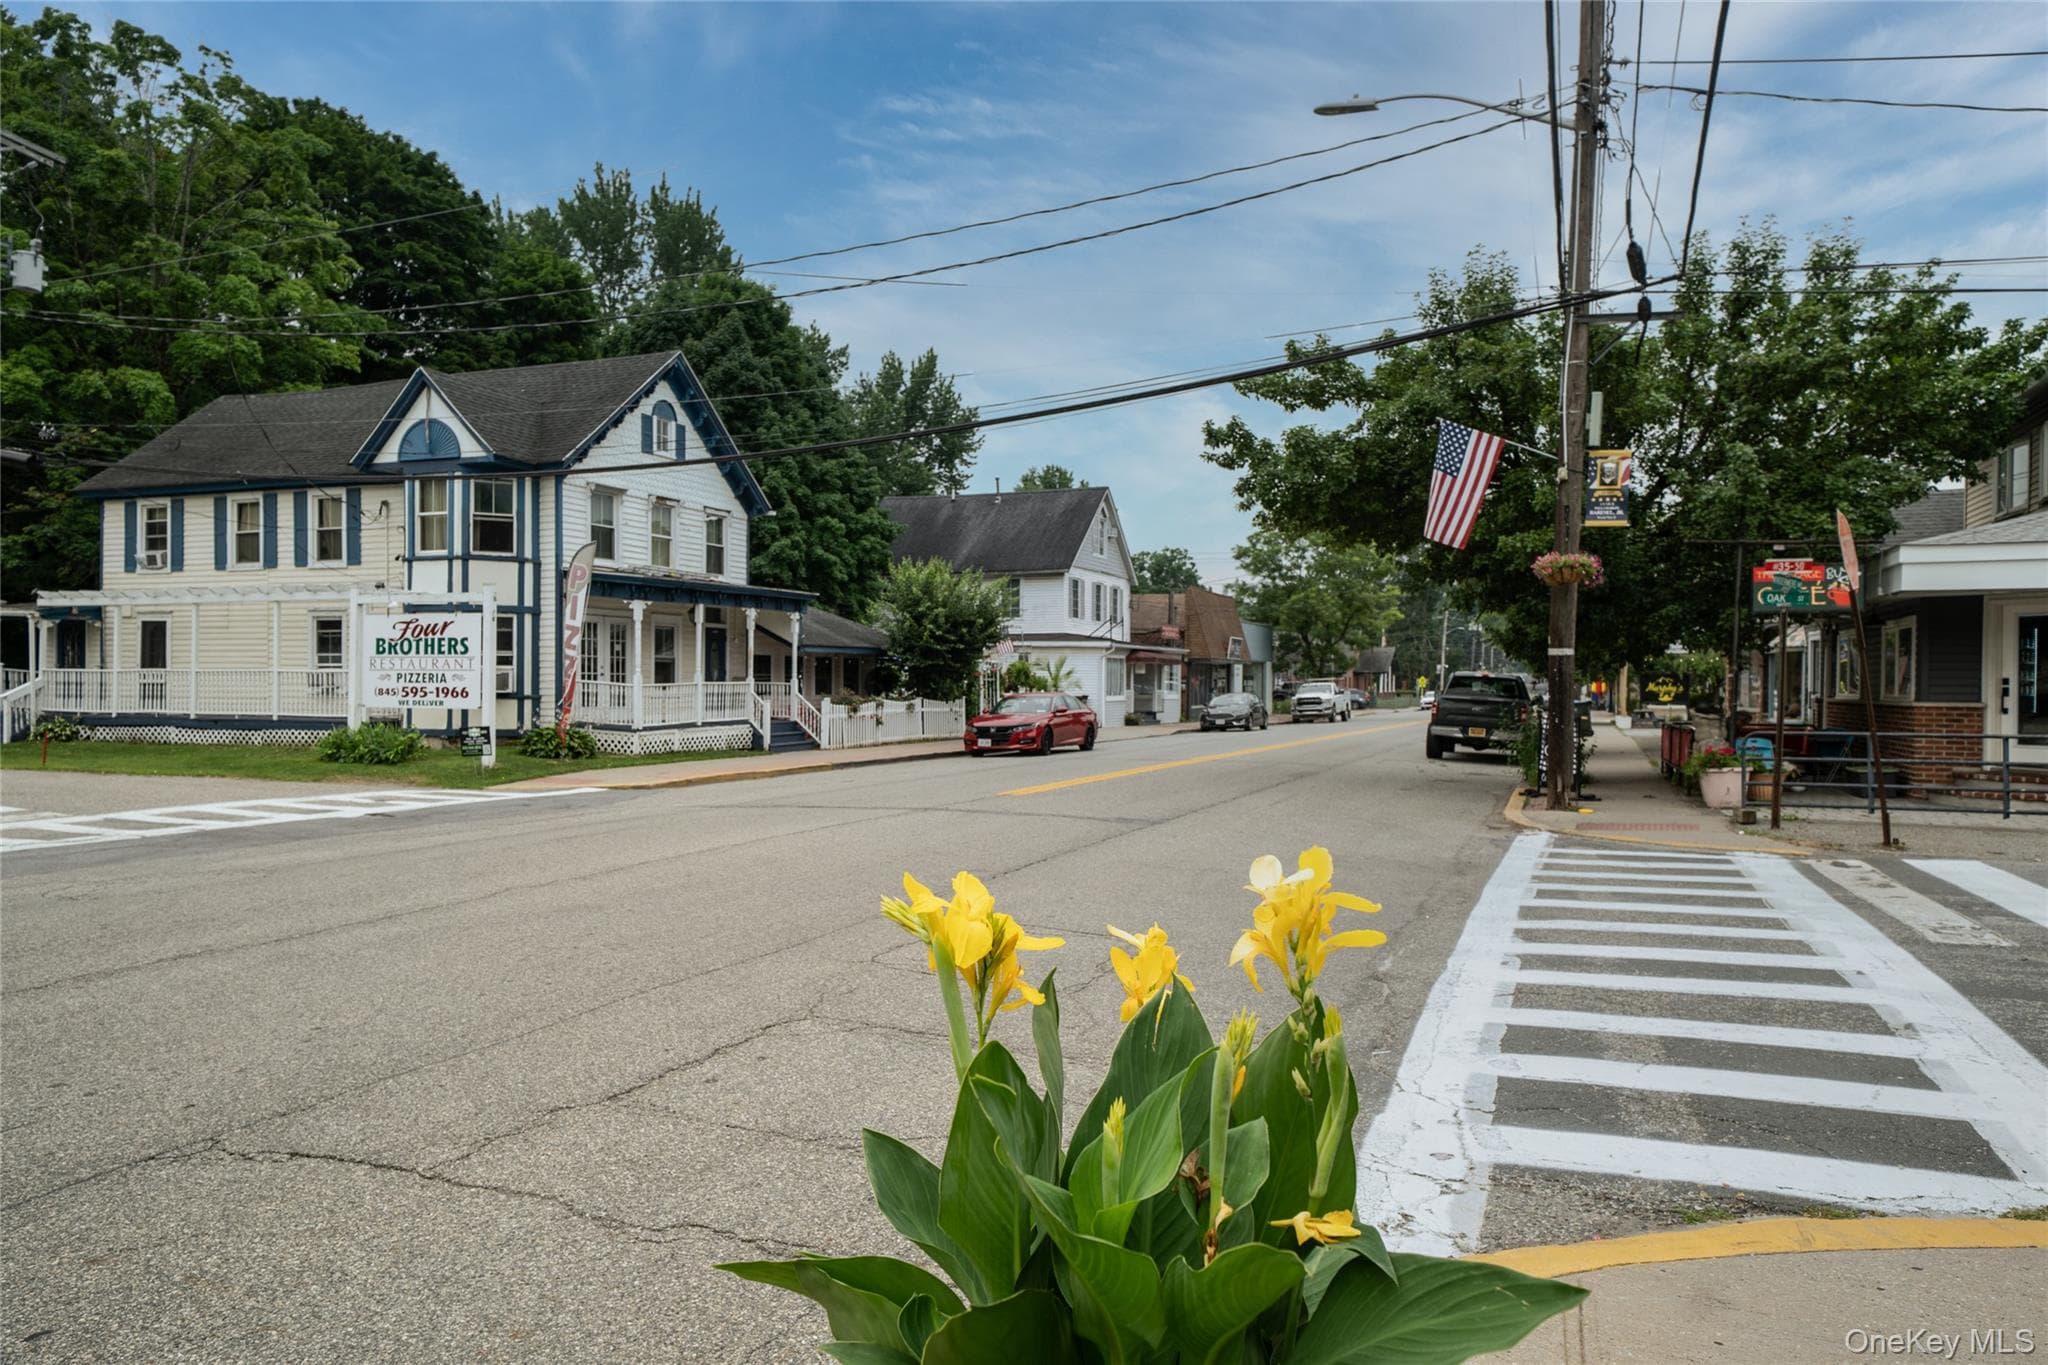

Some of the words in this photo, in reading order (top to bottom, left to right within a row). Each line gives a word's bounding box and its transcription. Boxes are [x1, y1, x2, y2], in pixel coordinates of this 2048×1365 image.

[1767, 594, 1787, 603] OAK
[392, 617, 455, 642] Four
[375, 637, 469, 655] BROTHERS
[369, 658, 476, 670] RESTAURANT
[396, 673, 447, 683] PIZZERIA
[374, 687, 400, 697] (845)
[401, 686, 469, 698] 595-1966
